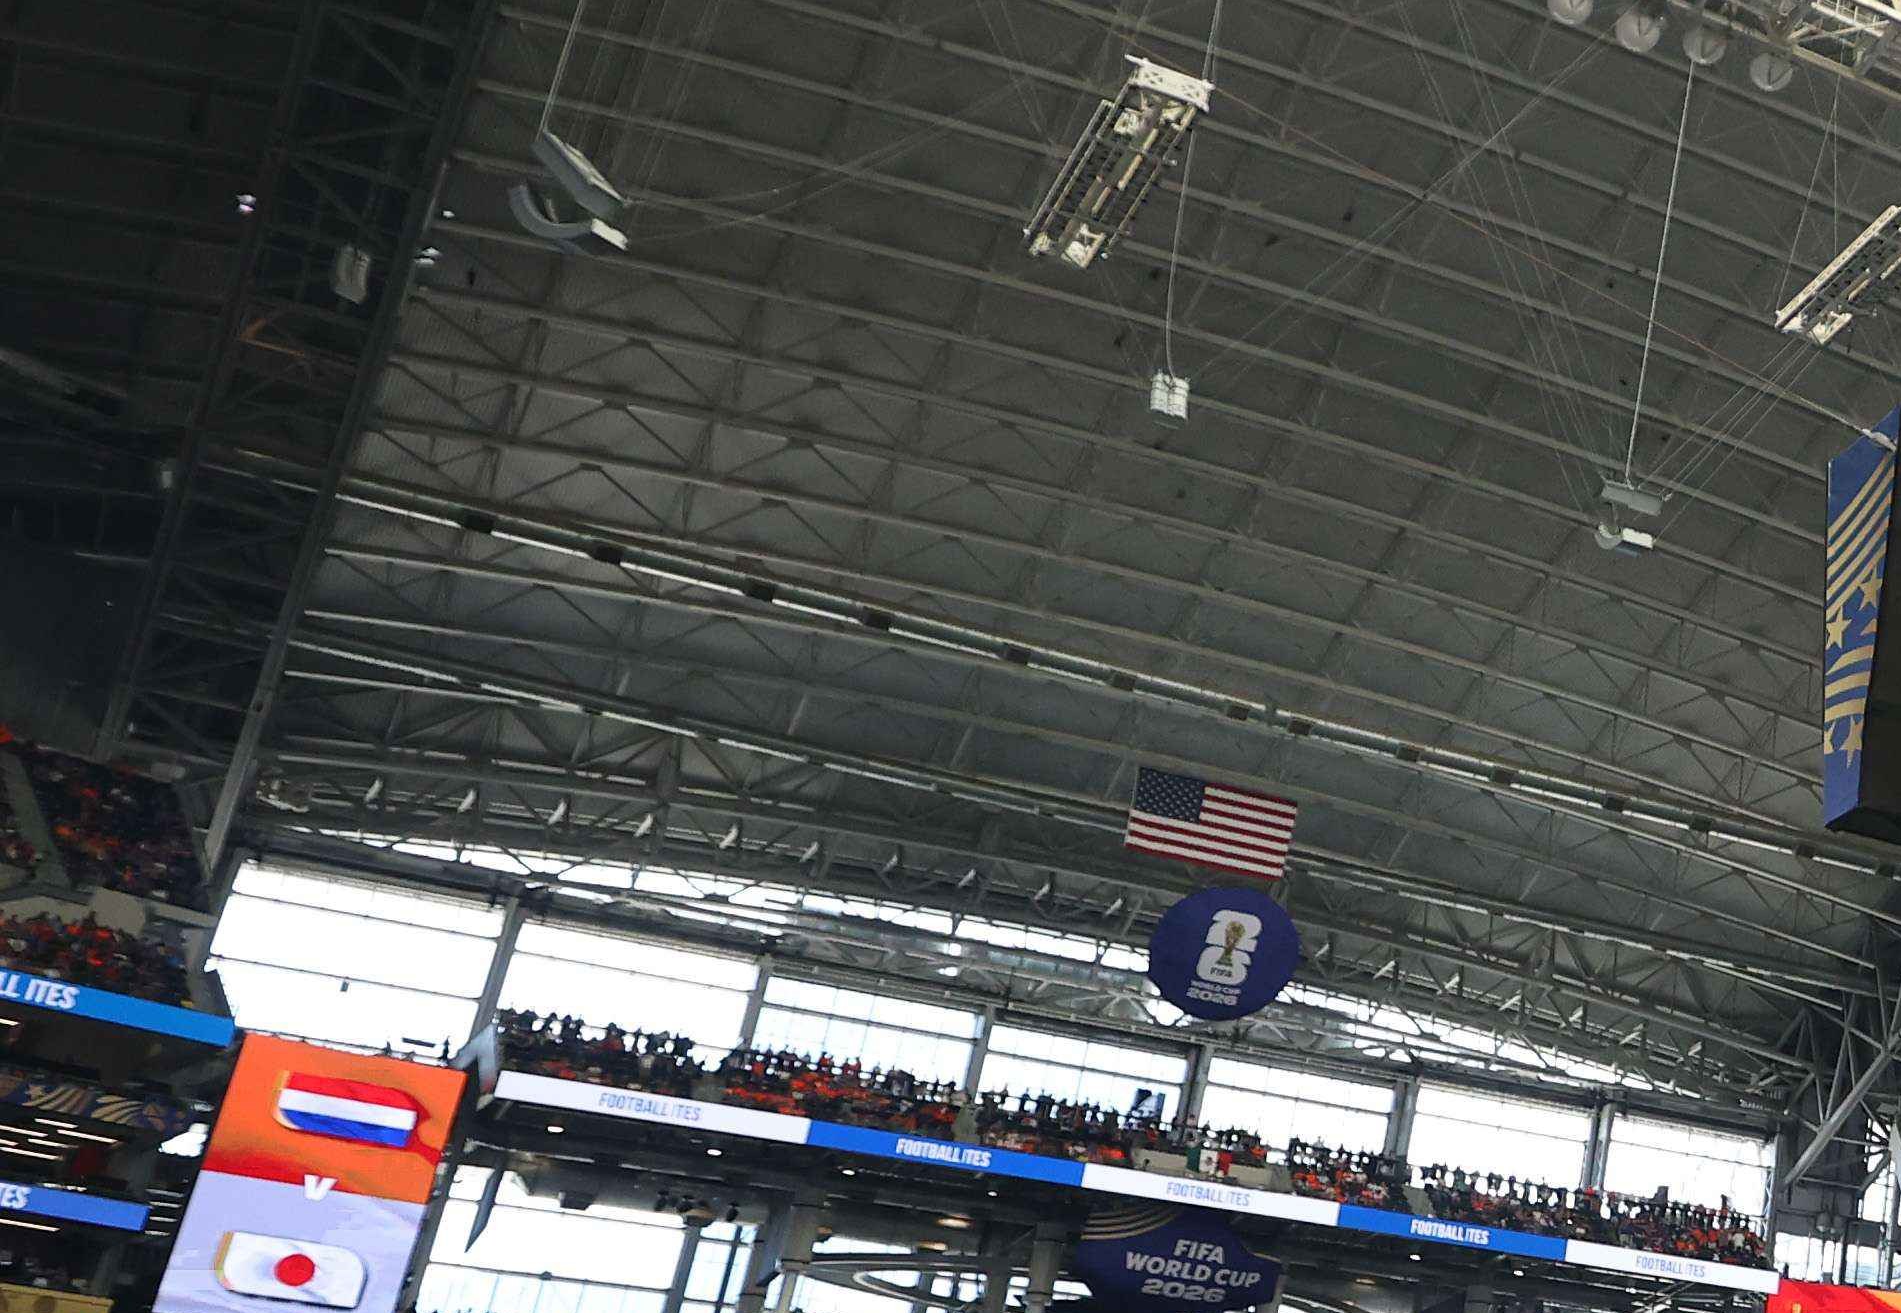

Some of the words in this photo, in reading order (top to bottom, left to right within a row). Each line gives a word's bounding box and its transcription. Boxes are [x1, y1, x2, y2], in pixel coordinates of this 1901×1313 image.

[601, 1092, 669, 1119] FOOTBALL
[897, 1138, 960, 1163] FOOTBALL
[1167, 1182, 1222, 1203] FOOTBALL
[1411, 1220, 1464, 1241] FOOTBALL
[1173, 1239, 1224, 1264] FIFA
[1125, 1251, 1211, 1282] WORLD
[1214, 1268, 1261, 1288] CUP
[1636, 1256, 1683, 1275] FOOTBALL
[1141, 1278, 1226, 1303] 2026
